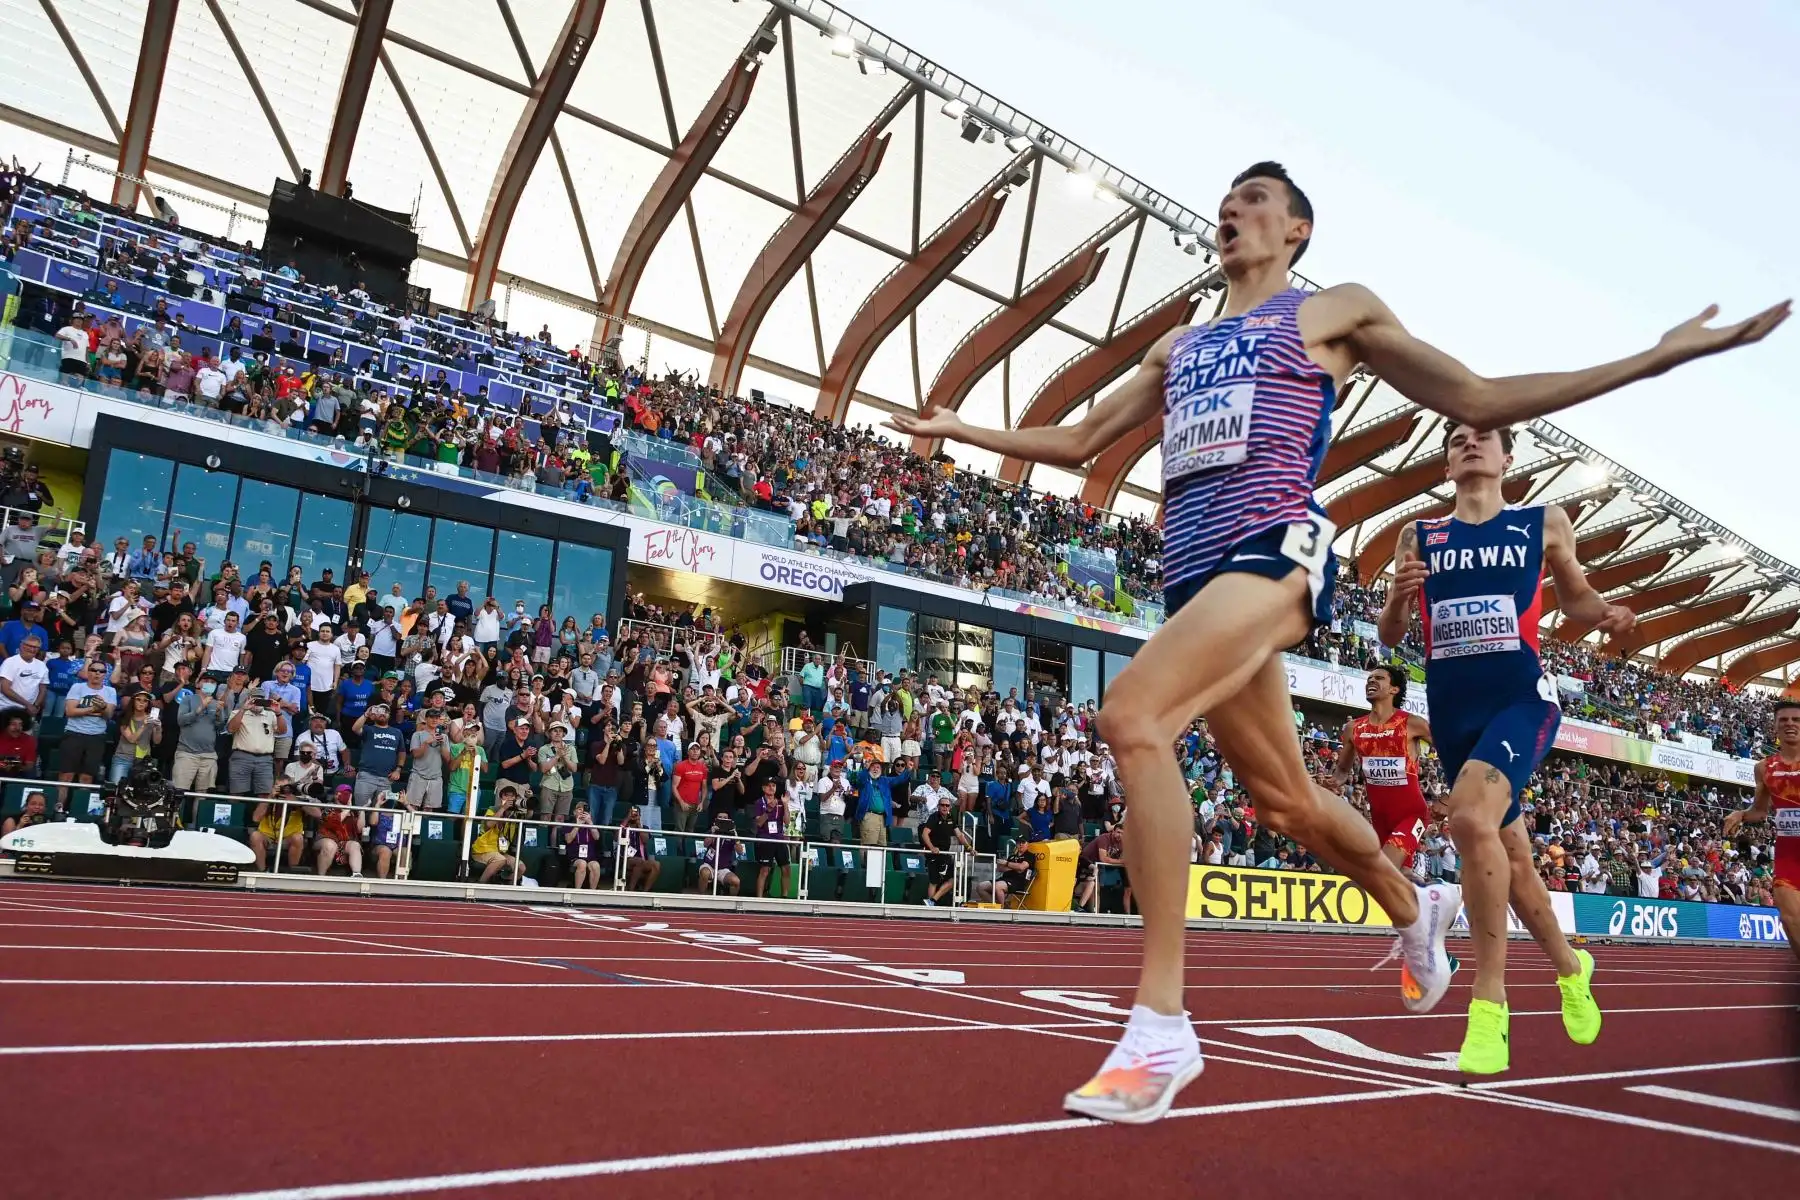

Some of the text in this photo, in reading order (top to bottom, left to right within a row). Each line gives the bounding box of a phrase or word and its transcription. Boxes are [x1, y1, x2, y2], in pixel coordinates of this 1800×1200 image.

[1180, 389, 1234, 421] TDK
[1298, 519, 1321, 558] 3
[644, 529, 673, 563] Feel
[681, 528, 716, 573] Glory
[1430, 545, 1527, 575] NORWAY
[761, 552, 787, 564] WORLD
[788, 558, 823, 573] ATHLETICS
[1449, 599, 1502, 617] TDK
[1433, 616, 1514, 642] INGEBRIGTSEN
[1443, 641, 1505, 657] OREGON22
[982, 767, 993, 775] USA
[1375, 759, 1399, 767] TDK
[1658, 753, 1694, 770] OREGON22
[1369, 768, 1398, 778] KATIR
[1778, 820, 1800, 829] GAR
[12, 837, 35, 848] rts
[1199, 870, 1370, 925] SEIKO
[1749, 913, 1789, 941] TDK
